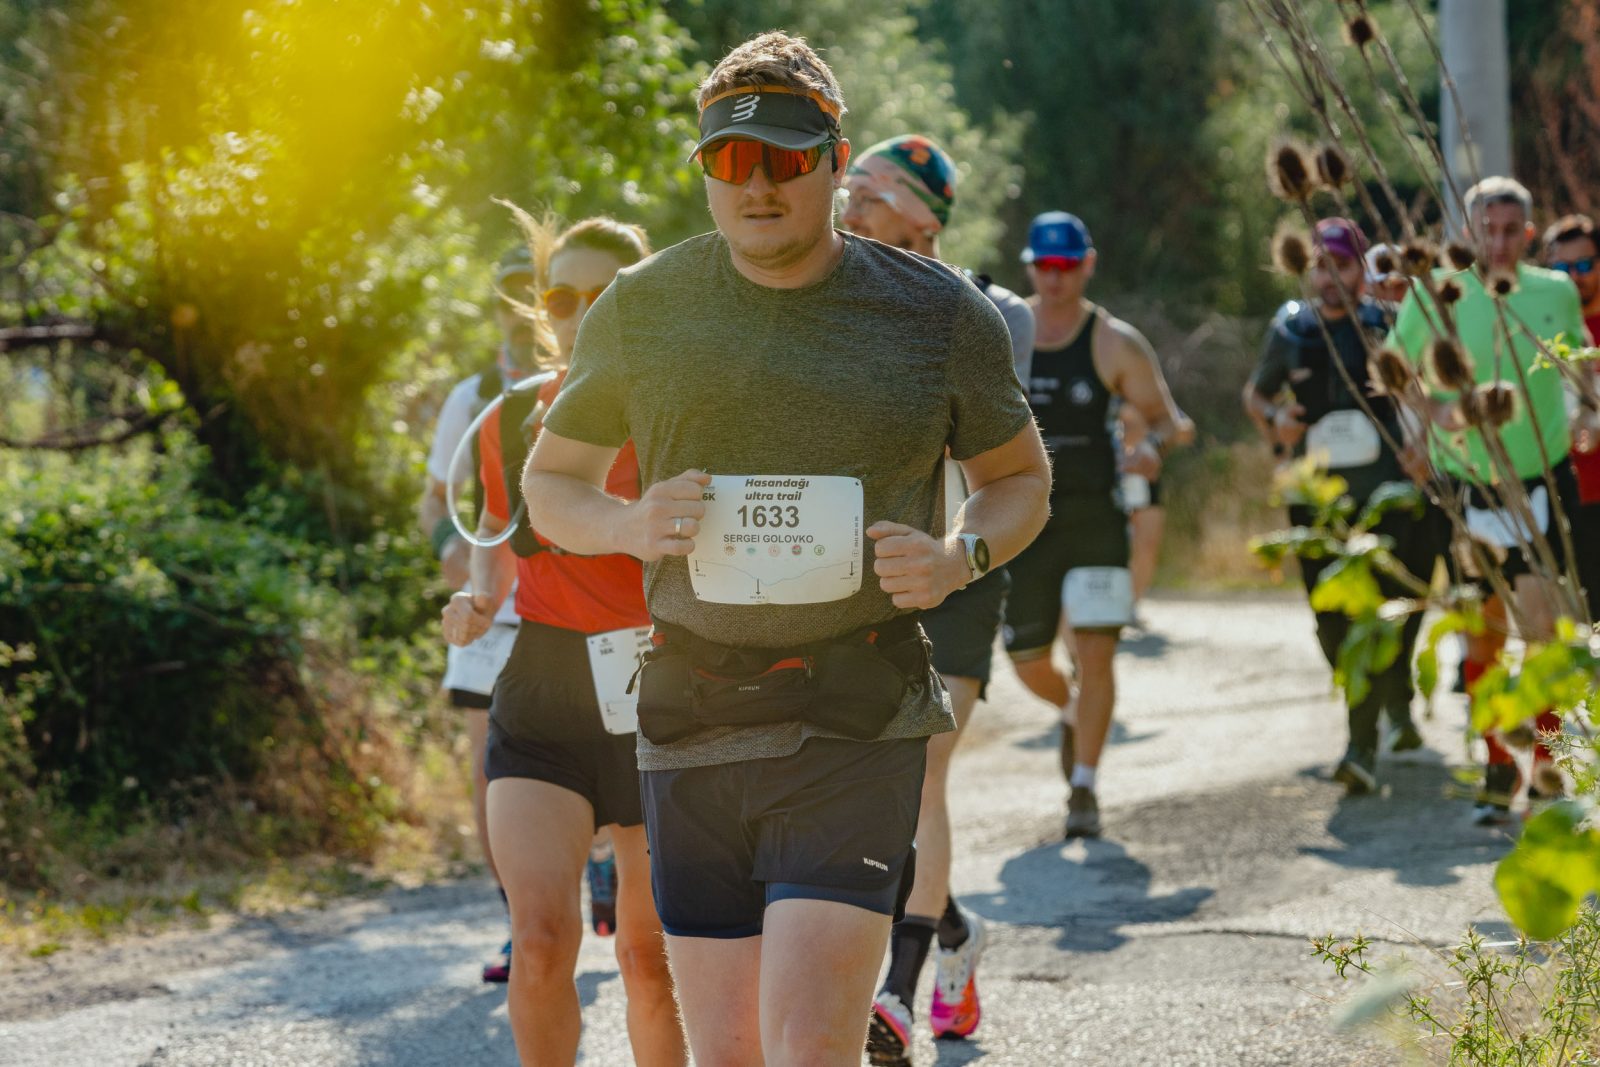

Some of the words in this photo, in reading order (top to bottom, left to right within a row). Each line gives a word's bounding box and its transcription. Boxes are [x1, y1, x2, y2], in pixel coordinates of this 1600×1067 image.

[745, 478, 809, 489] Hasandağı
[745, 491, 774, 501] ultra
[777, 491, 802, 501] trail
[737, 505, 800, 528] 1633
[723, 534, 760, 543] SERGEI
[762, 534, 814, 544] GOLOVKO
[863, 857, 889, 871] KIPRUN
